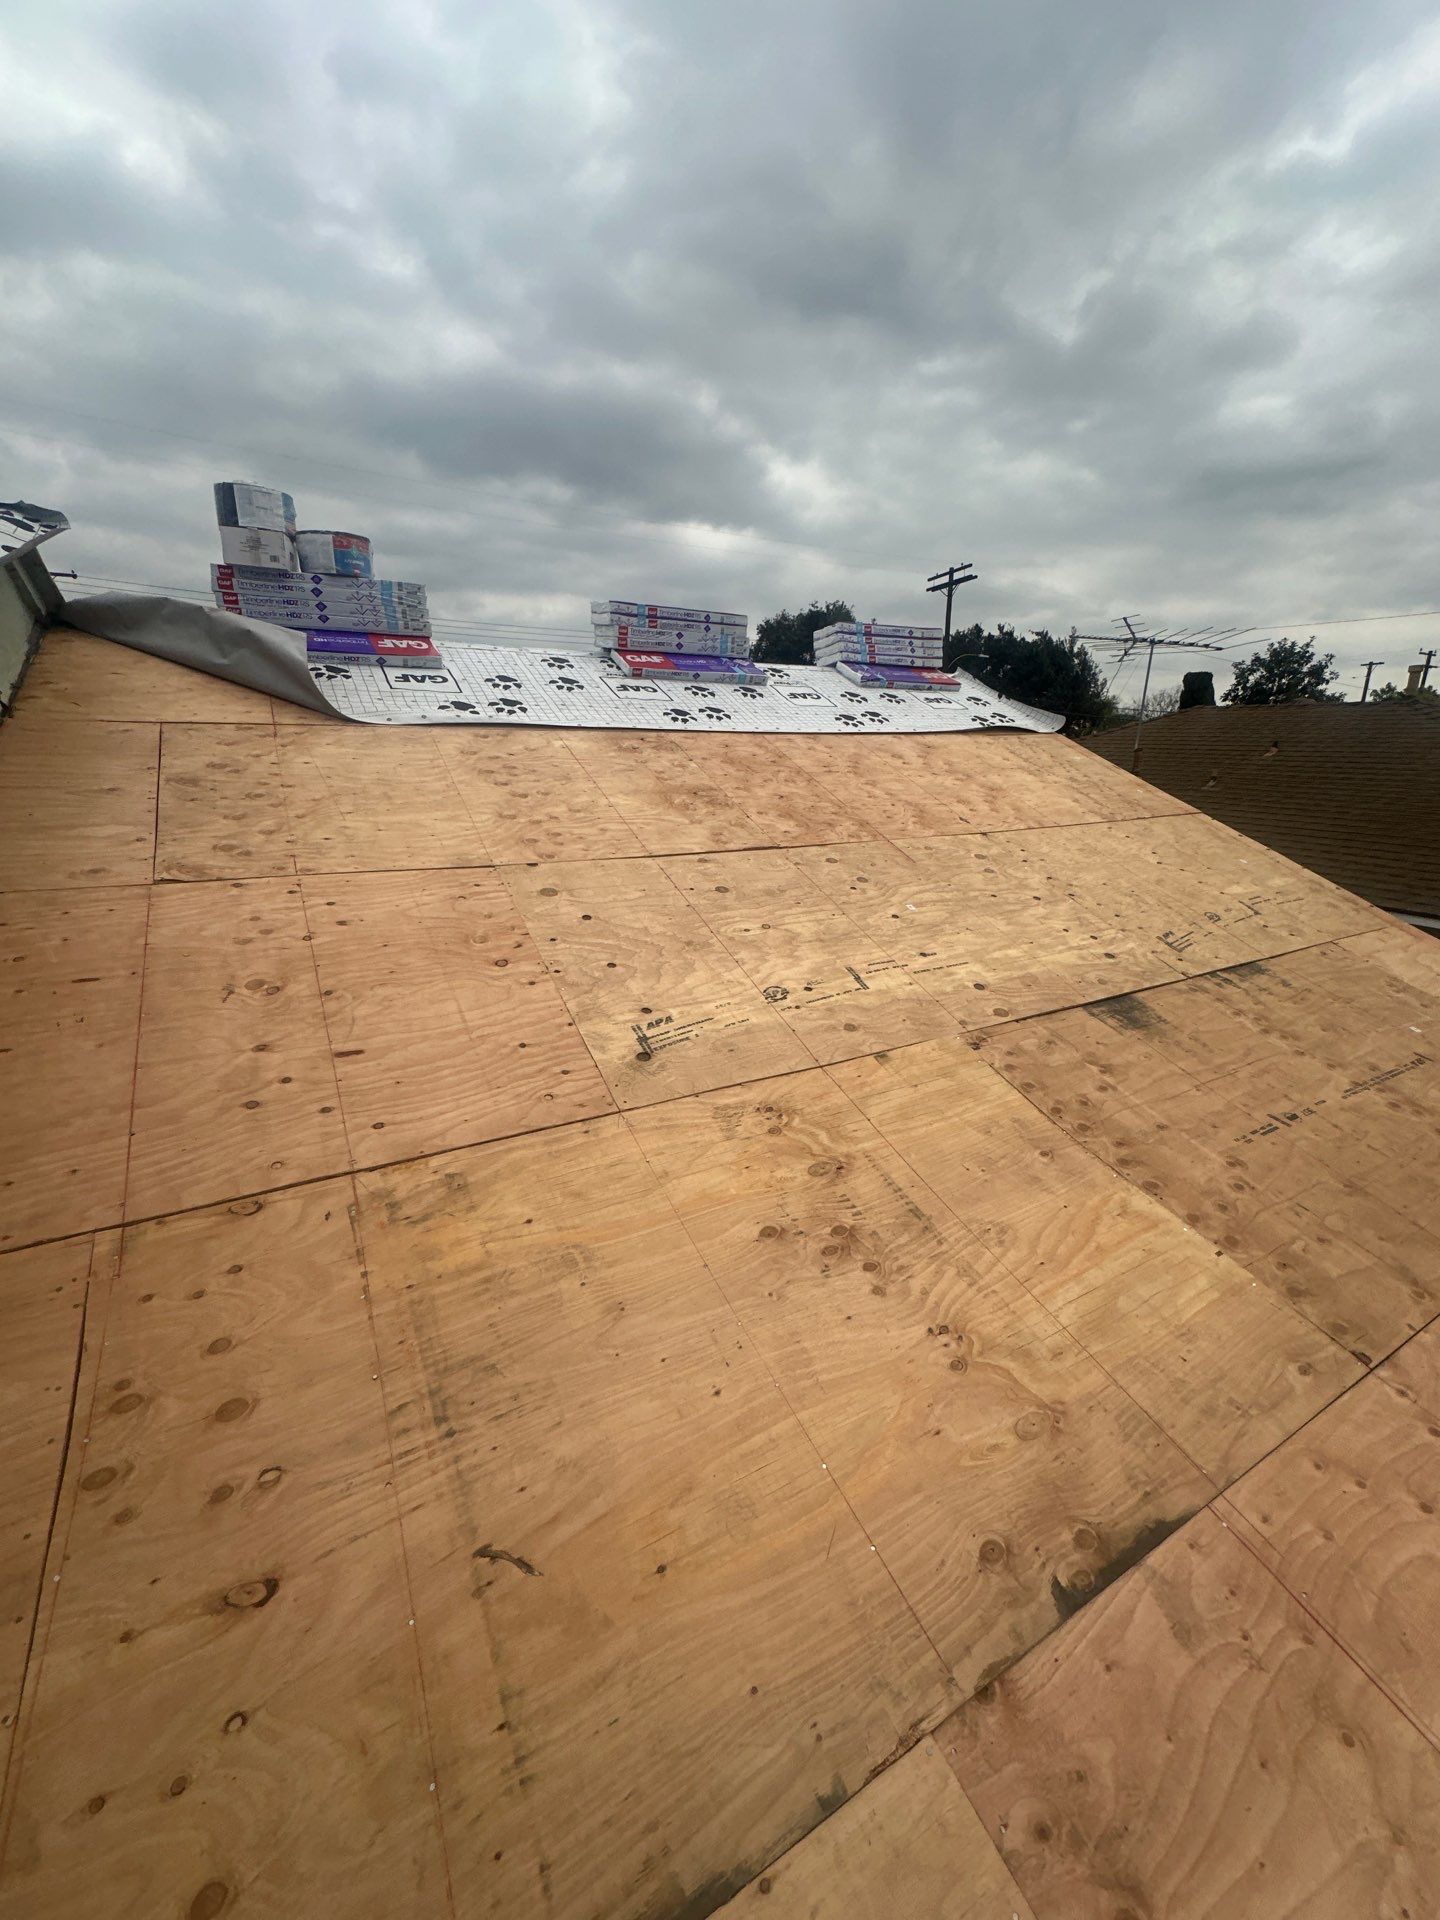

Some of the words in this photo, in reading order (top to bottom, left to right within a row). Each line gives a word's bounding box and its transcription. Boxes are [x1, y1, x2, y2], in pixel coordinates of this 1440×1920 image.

[378, 639, 429, 649] GAF
[625, 655, 665, 664] GAF
[394, 673, 448, 684] GAF
[616, 684, 658, 693] GAF
[788, 692, 822, 700] GAF
[646, 1016, 674, 1030] APA
